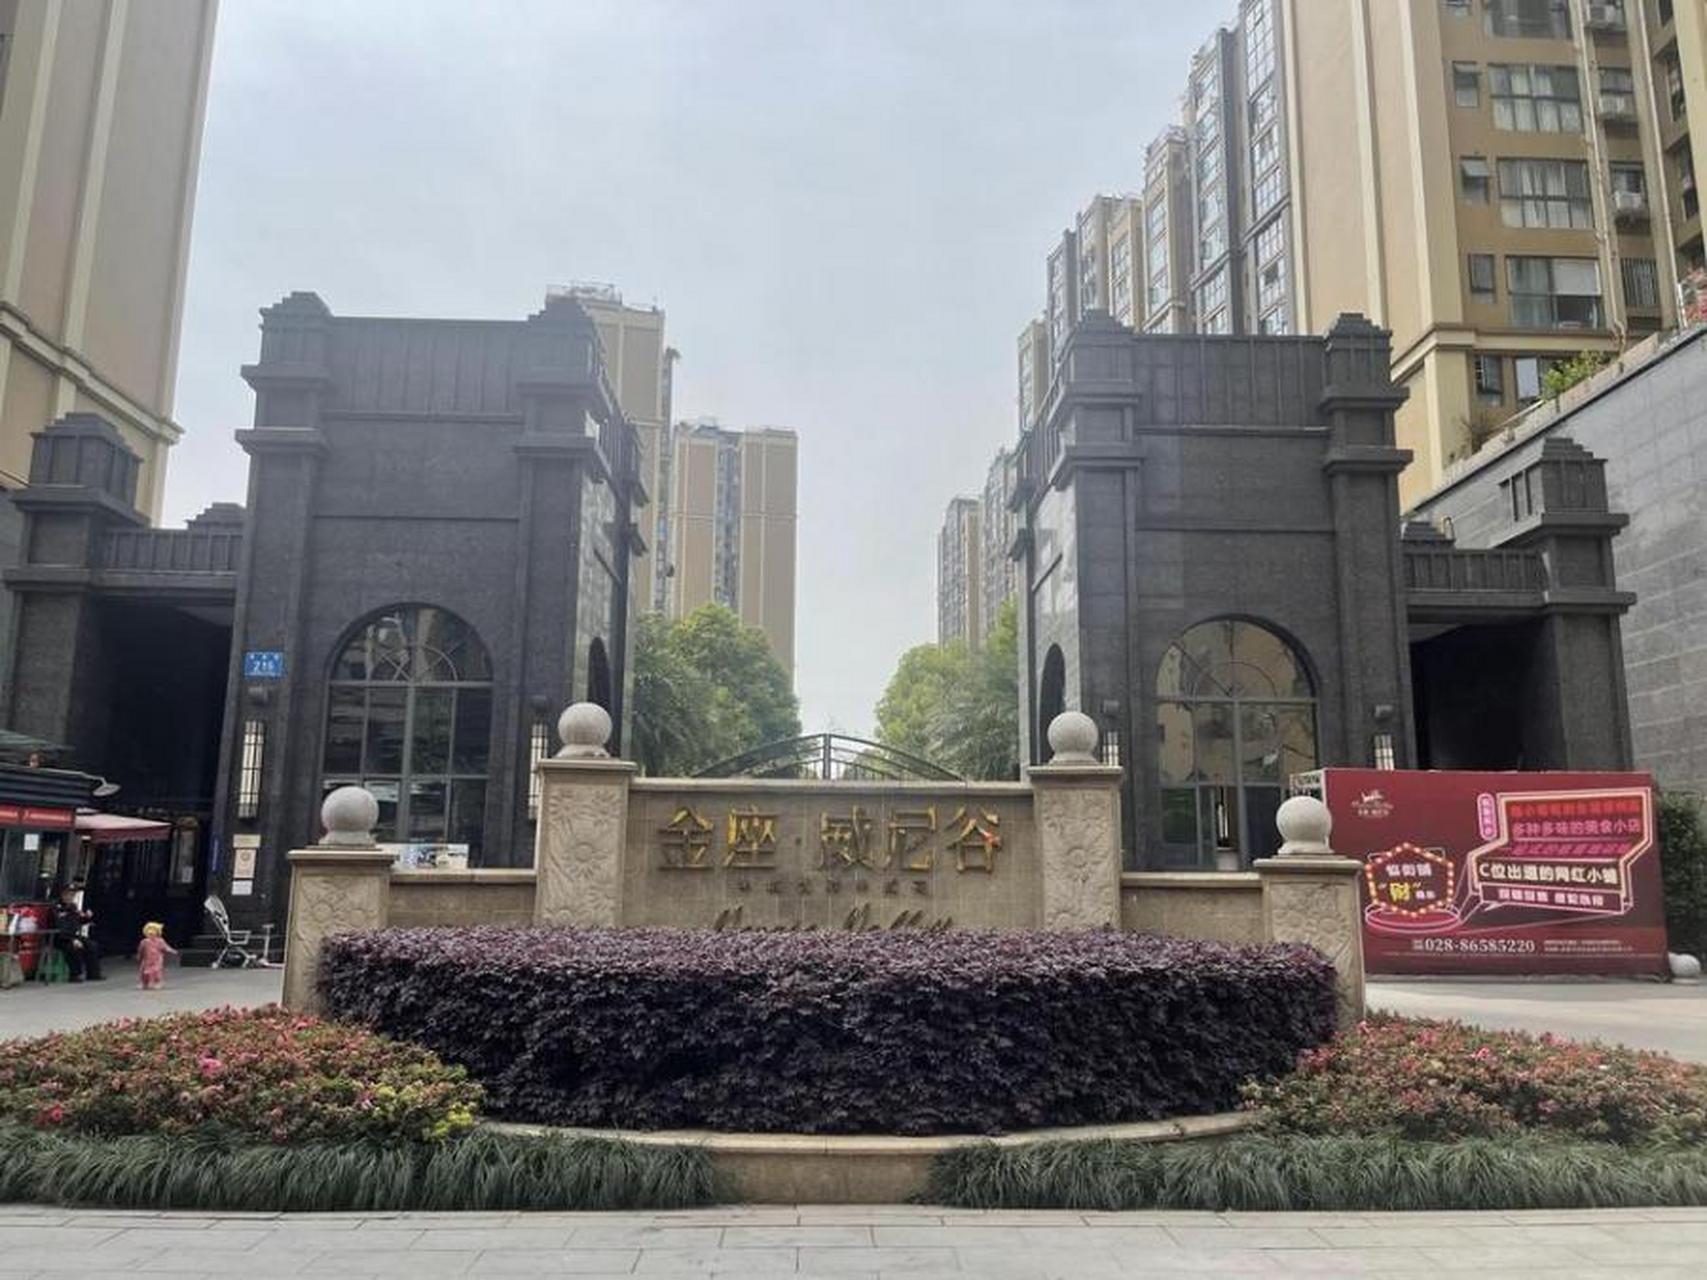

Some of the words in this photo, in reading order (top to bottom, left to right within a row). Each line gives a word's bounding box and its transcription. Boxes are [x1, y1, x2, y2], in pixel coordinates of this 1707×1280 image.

[1479, 863, 1619, 885] C位出道的网红小铺
[1425, 937, 1536, 954] 028-86585220
